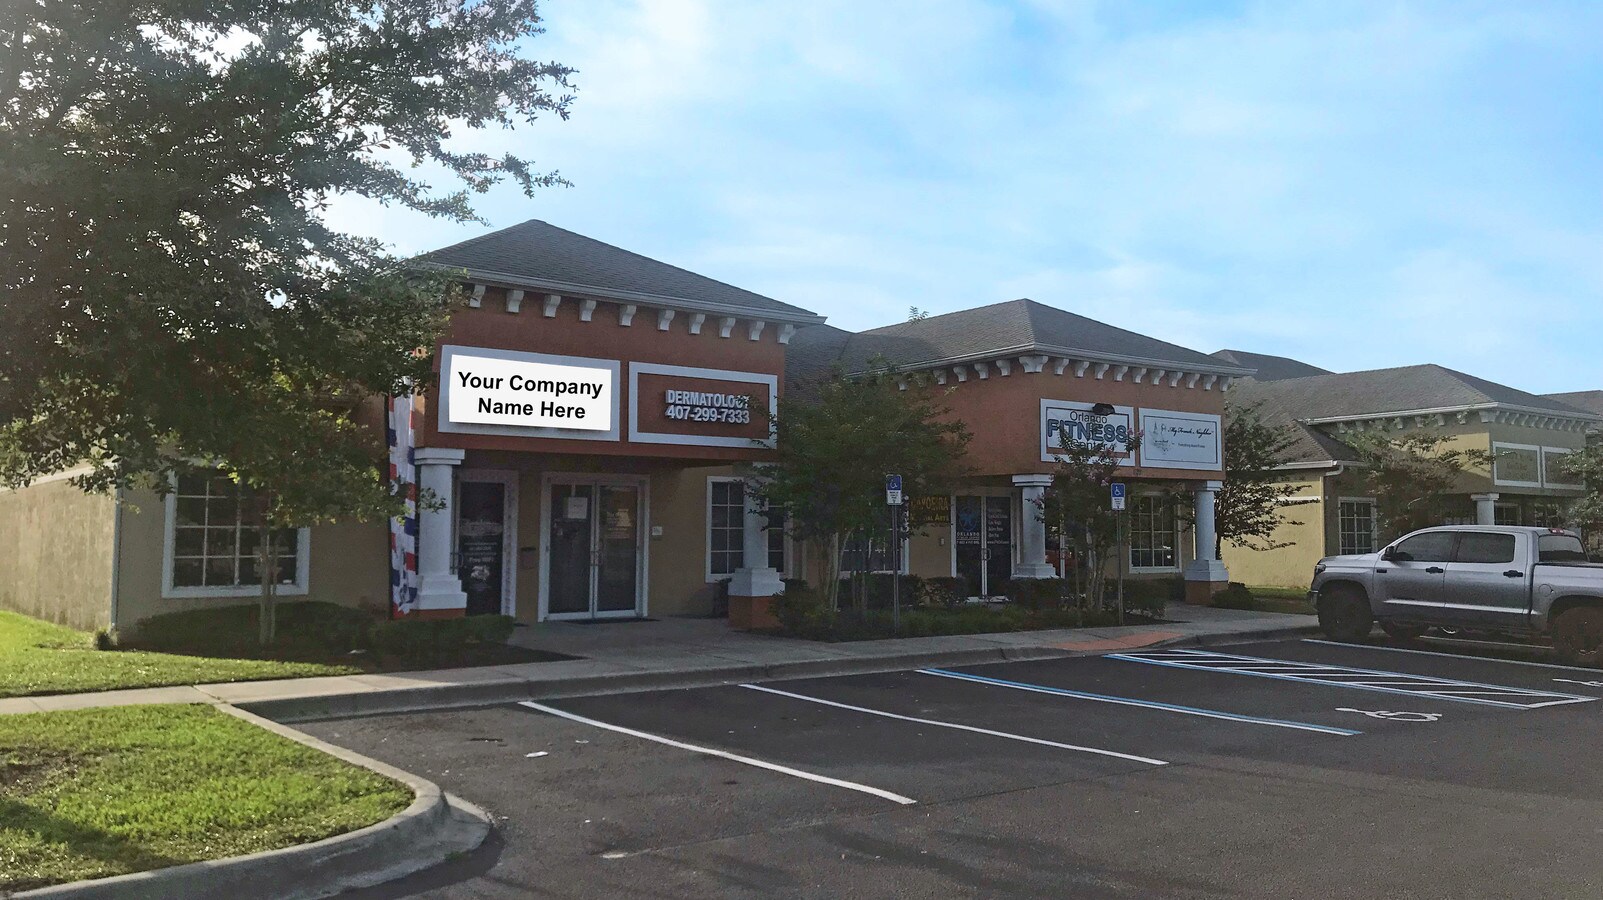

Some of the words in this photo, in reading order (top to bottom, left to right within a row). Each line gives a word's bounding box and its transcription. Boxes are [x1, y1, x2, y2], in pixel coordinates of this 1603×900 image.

[458, 371, 504, 390] Your
[509, 374, 604, 400] Company
[478, 397, 534, 416] Name
[540, 400, 586, 419] Here
[665, 405, 751, 424] 407-299-7333
[1069, 410, 1108, 425] Orlando
[1047, 418, 1127, 443] FITNESS
[1071, 438, 1107, 449] Centr
